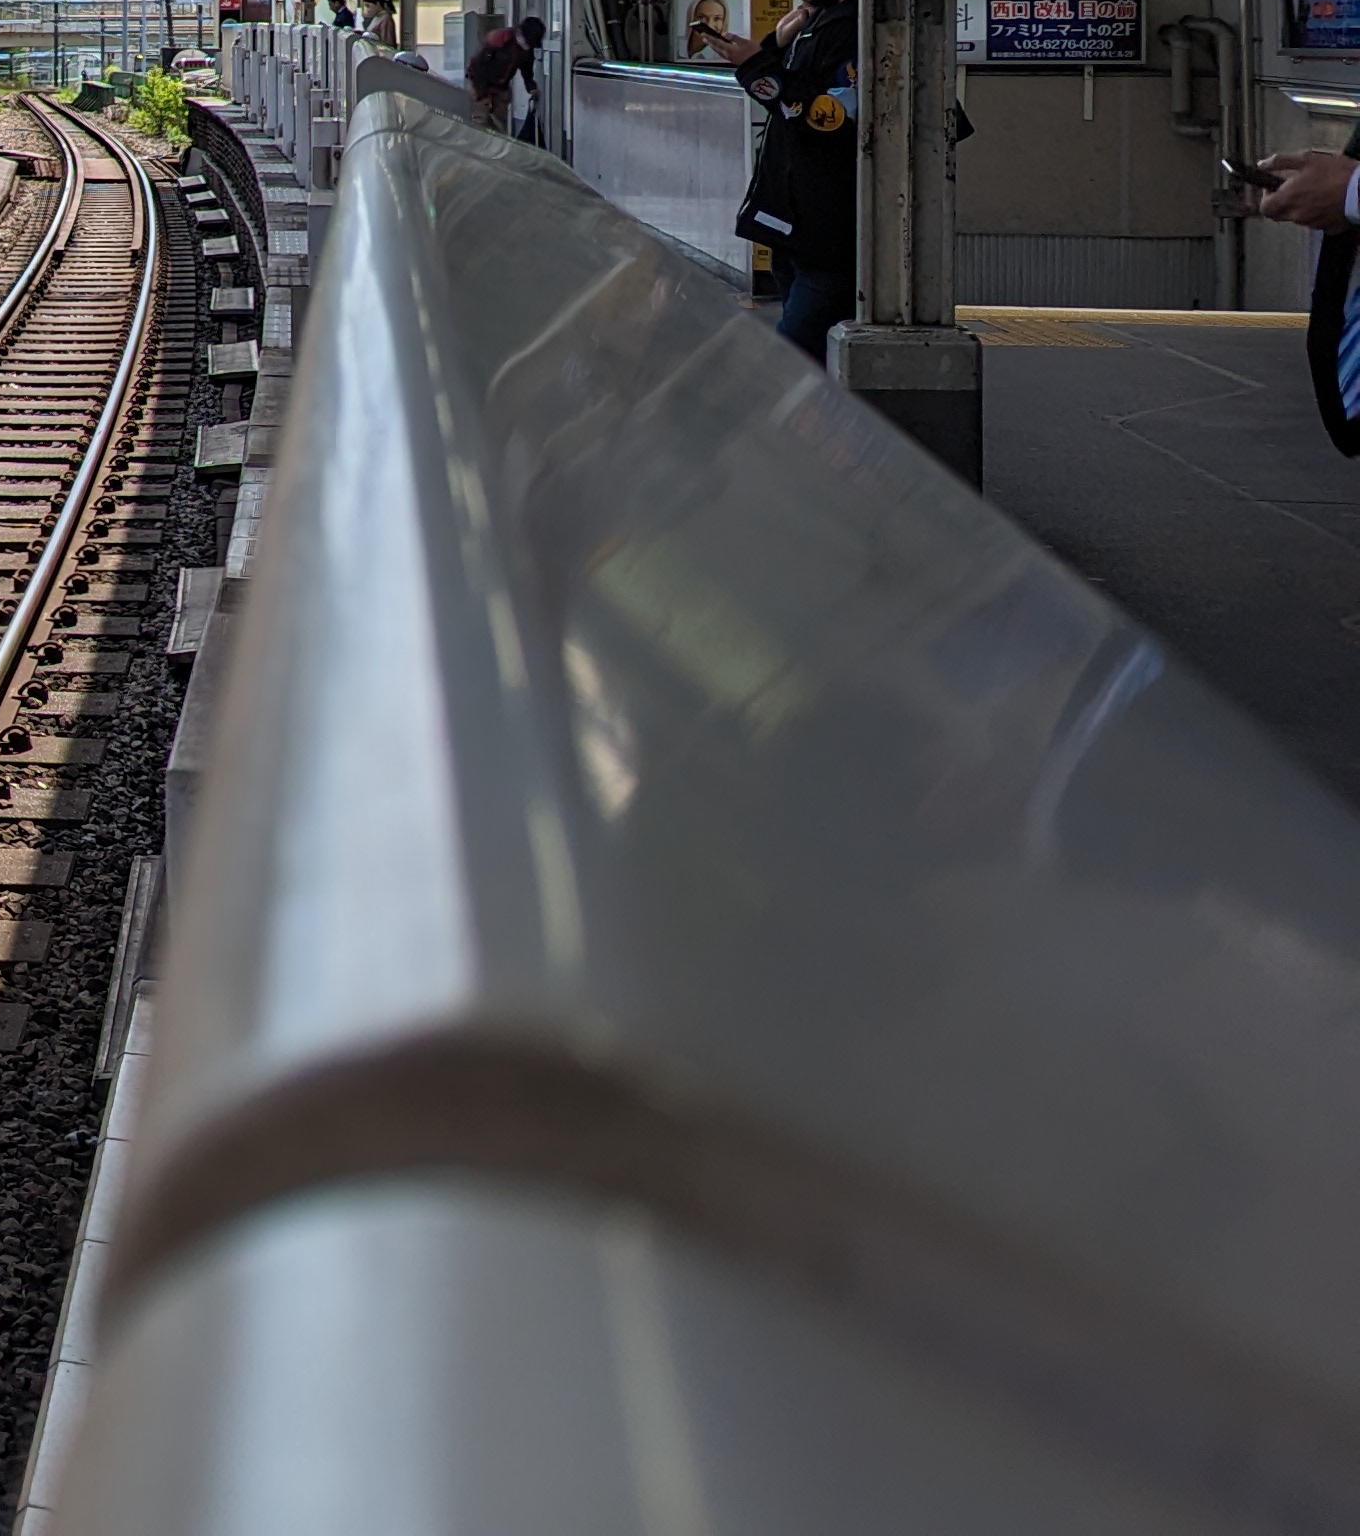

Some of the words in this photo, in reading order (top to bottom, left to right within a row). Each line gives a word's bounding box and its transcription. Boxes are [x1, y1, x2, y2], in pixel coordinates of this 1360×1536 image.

[991, 1, 1030, 20] 西口
[1034, 0, 1074, 20] 改札
[1079, 0, 1137, 20] 目の前
[990, 22, 1136, 37] ファミリーマートの2F
